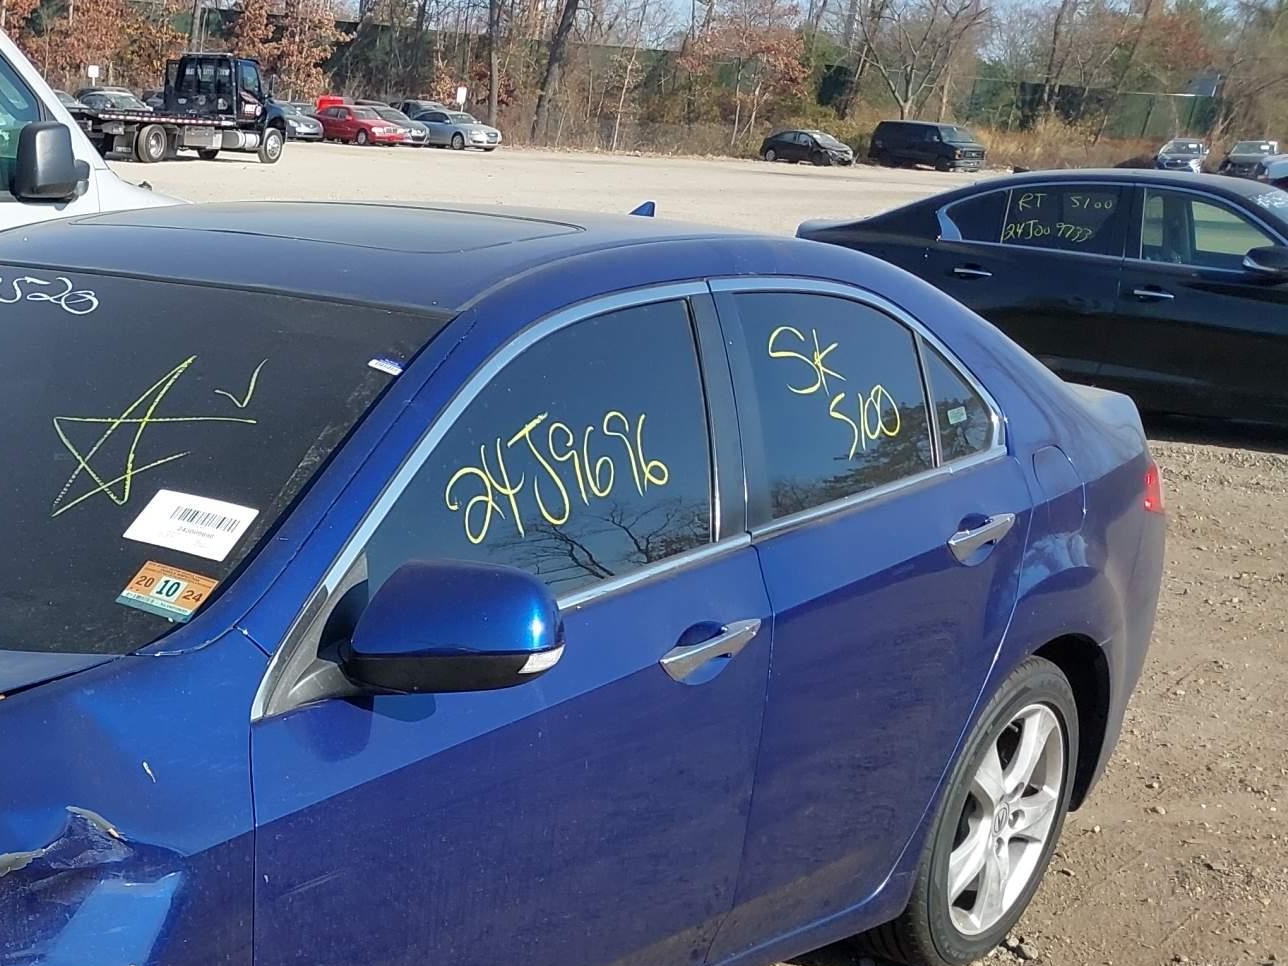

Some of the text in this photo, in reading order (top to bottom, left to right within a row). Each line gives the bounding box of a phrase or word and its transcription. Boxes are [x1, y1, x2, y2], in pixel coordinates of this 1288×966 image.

[1018, 192, 1049, 212] RT
[445, 411, 669, 544] 24J9696
[134, 575, 203, 602] 20 10 24
